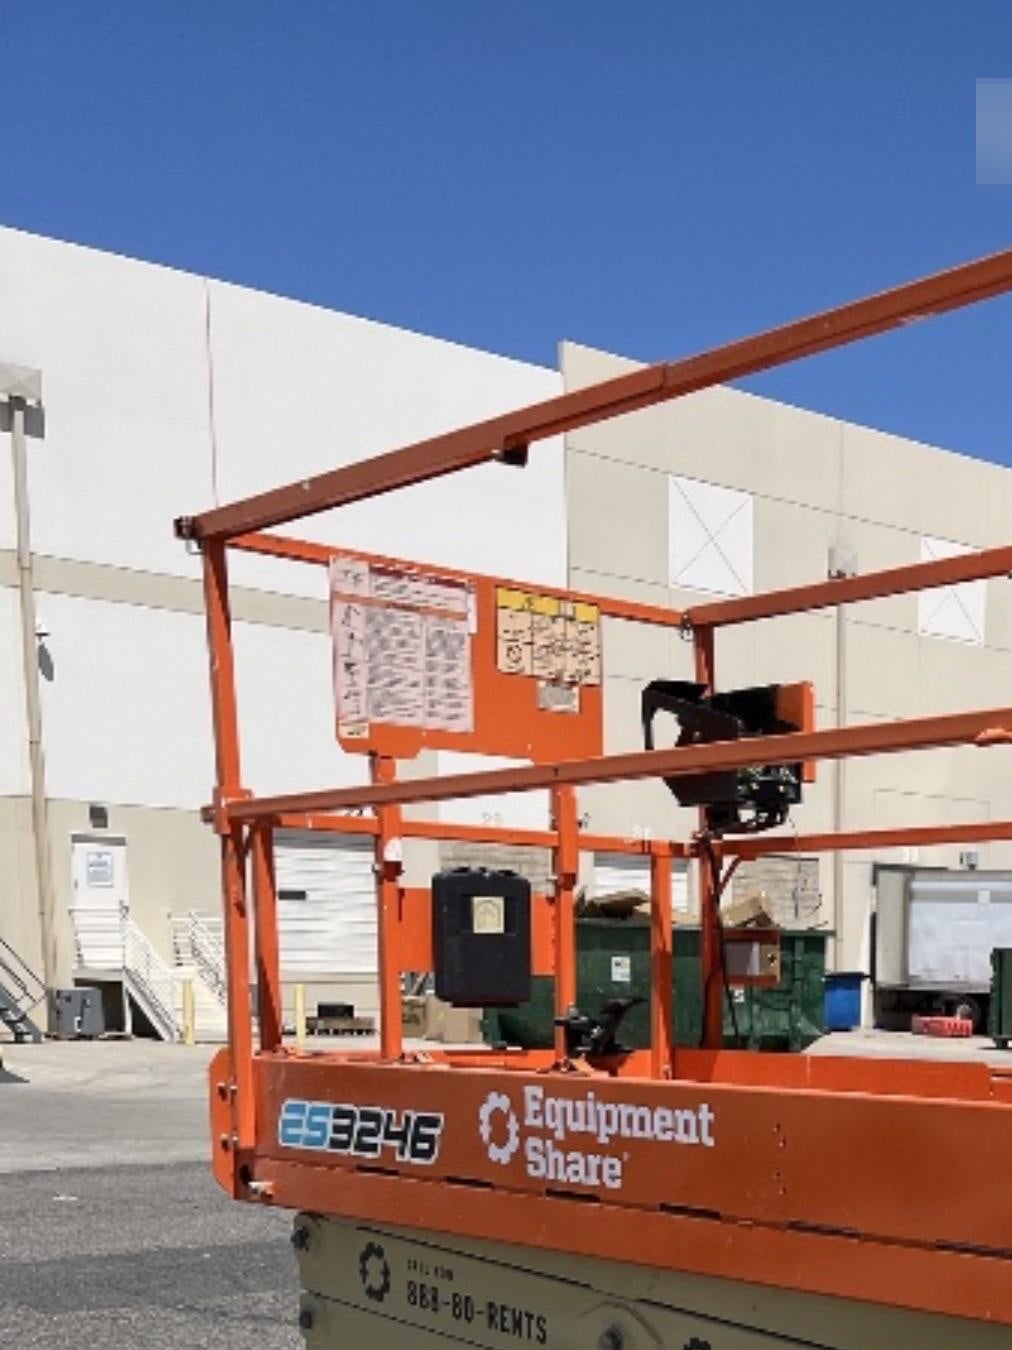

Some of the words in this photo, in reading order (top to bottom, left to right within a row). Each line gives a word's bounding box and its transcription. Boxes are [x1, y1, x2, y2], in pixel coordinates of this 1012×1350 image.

[279, 1099, 444, 1164] ES3246
[524, 1085, 715, 1147] Equipment
[525, 1136, 622, 1189] Share
[407, 1280, 548, 1345] 888-80-RENTS
